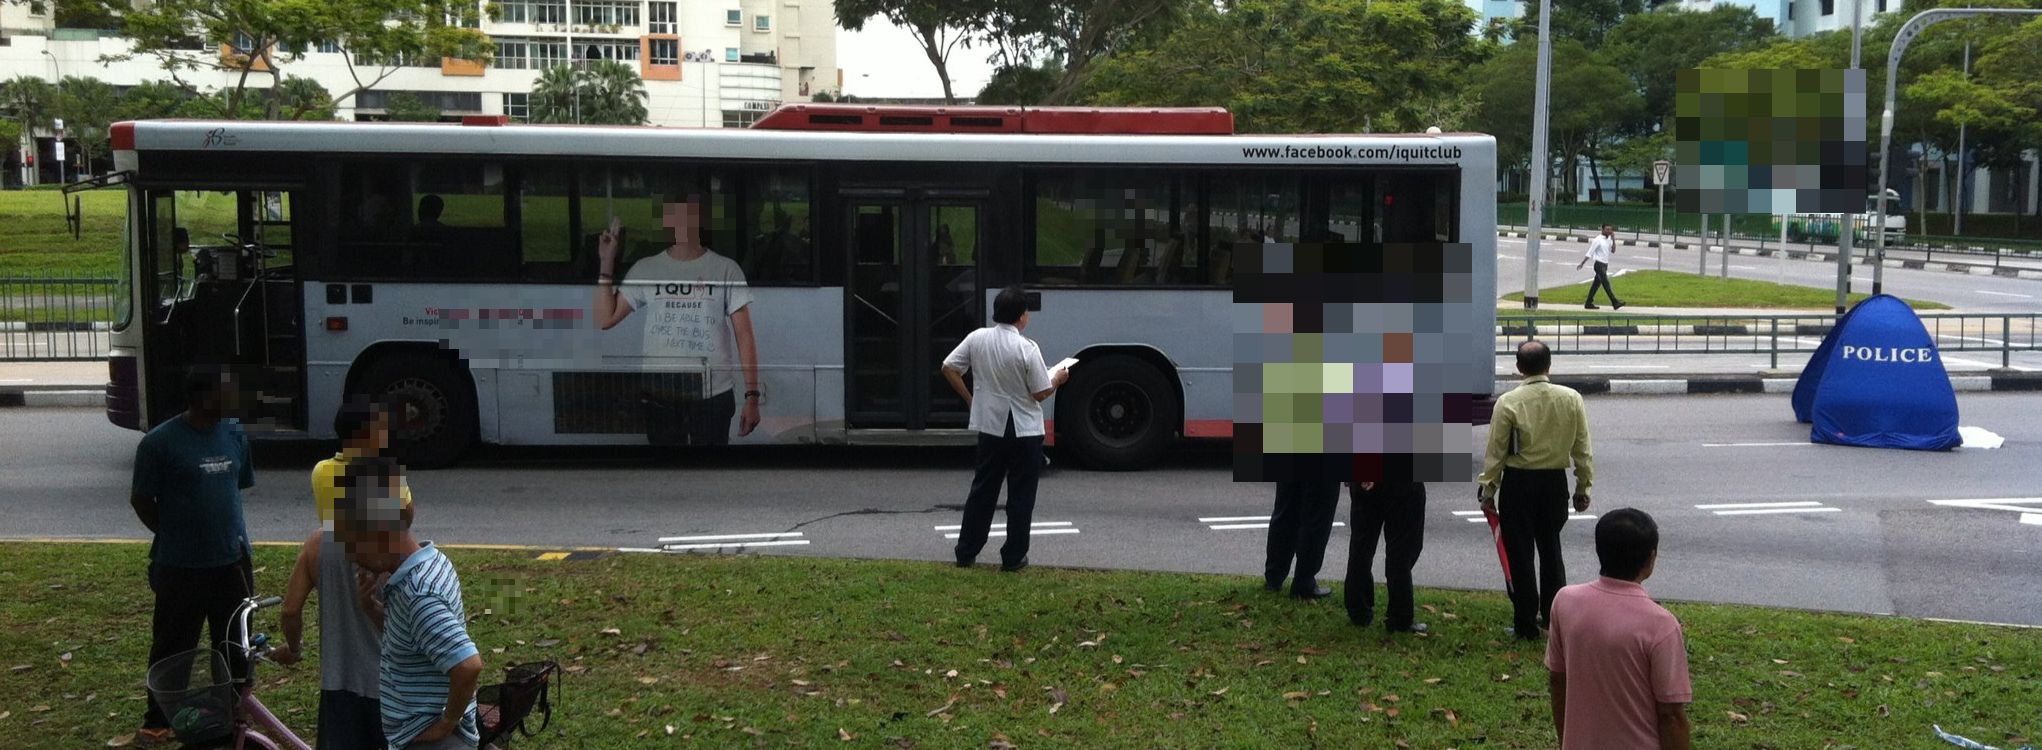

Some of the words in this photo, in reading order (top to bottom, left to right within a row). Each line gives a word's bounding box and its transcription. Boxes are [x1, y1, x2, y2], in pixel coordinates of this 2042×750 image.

[1242, 145, 1462, 162] www.facebook.com/iquitclub
[655, 283, 661, 296] I
[665, 301, 701, 309] BECAUSE
[402, 315, 414, 325] Be
[1843, 345, 1932, 363] POLICE
